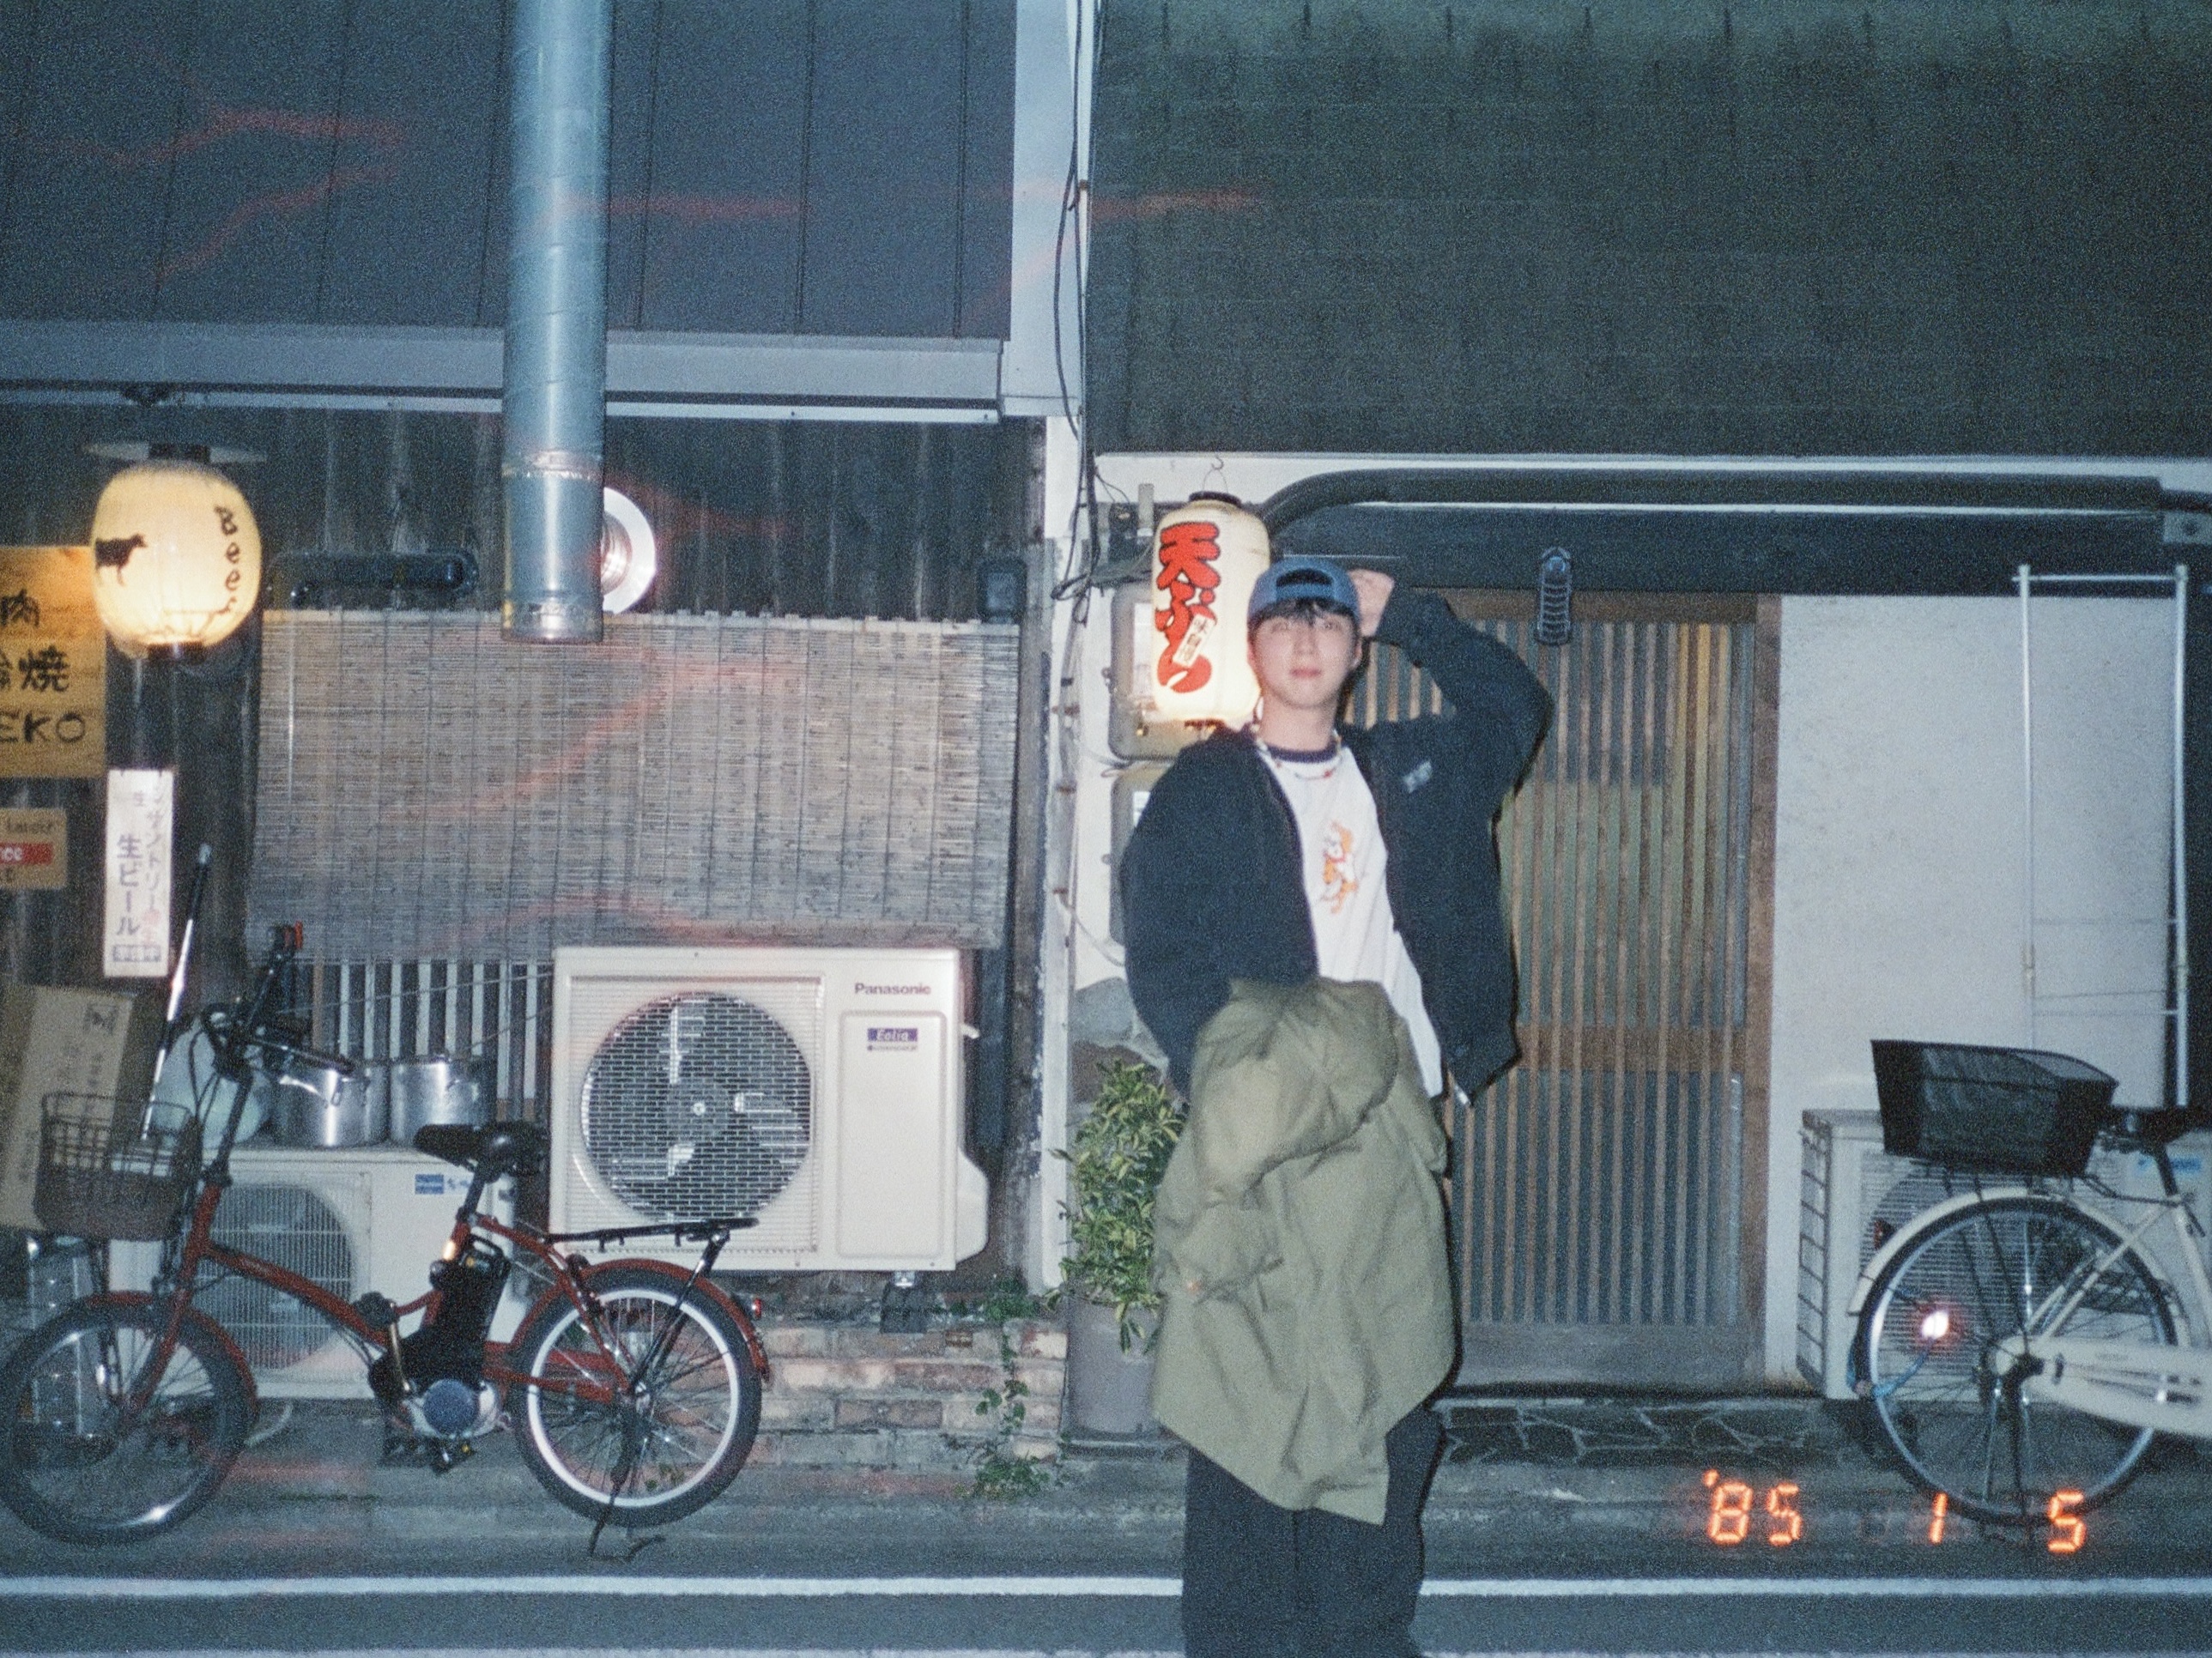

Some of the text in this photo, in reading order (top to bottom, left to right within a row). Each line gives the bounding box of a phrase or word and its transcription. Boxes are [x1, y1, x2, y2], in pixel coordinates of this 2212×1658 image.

[1156, 521, 1221, 693] 天ぷら
[117, 833, 142, 935] 生ビール
[855, 982, 931, 995] Panasonic
